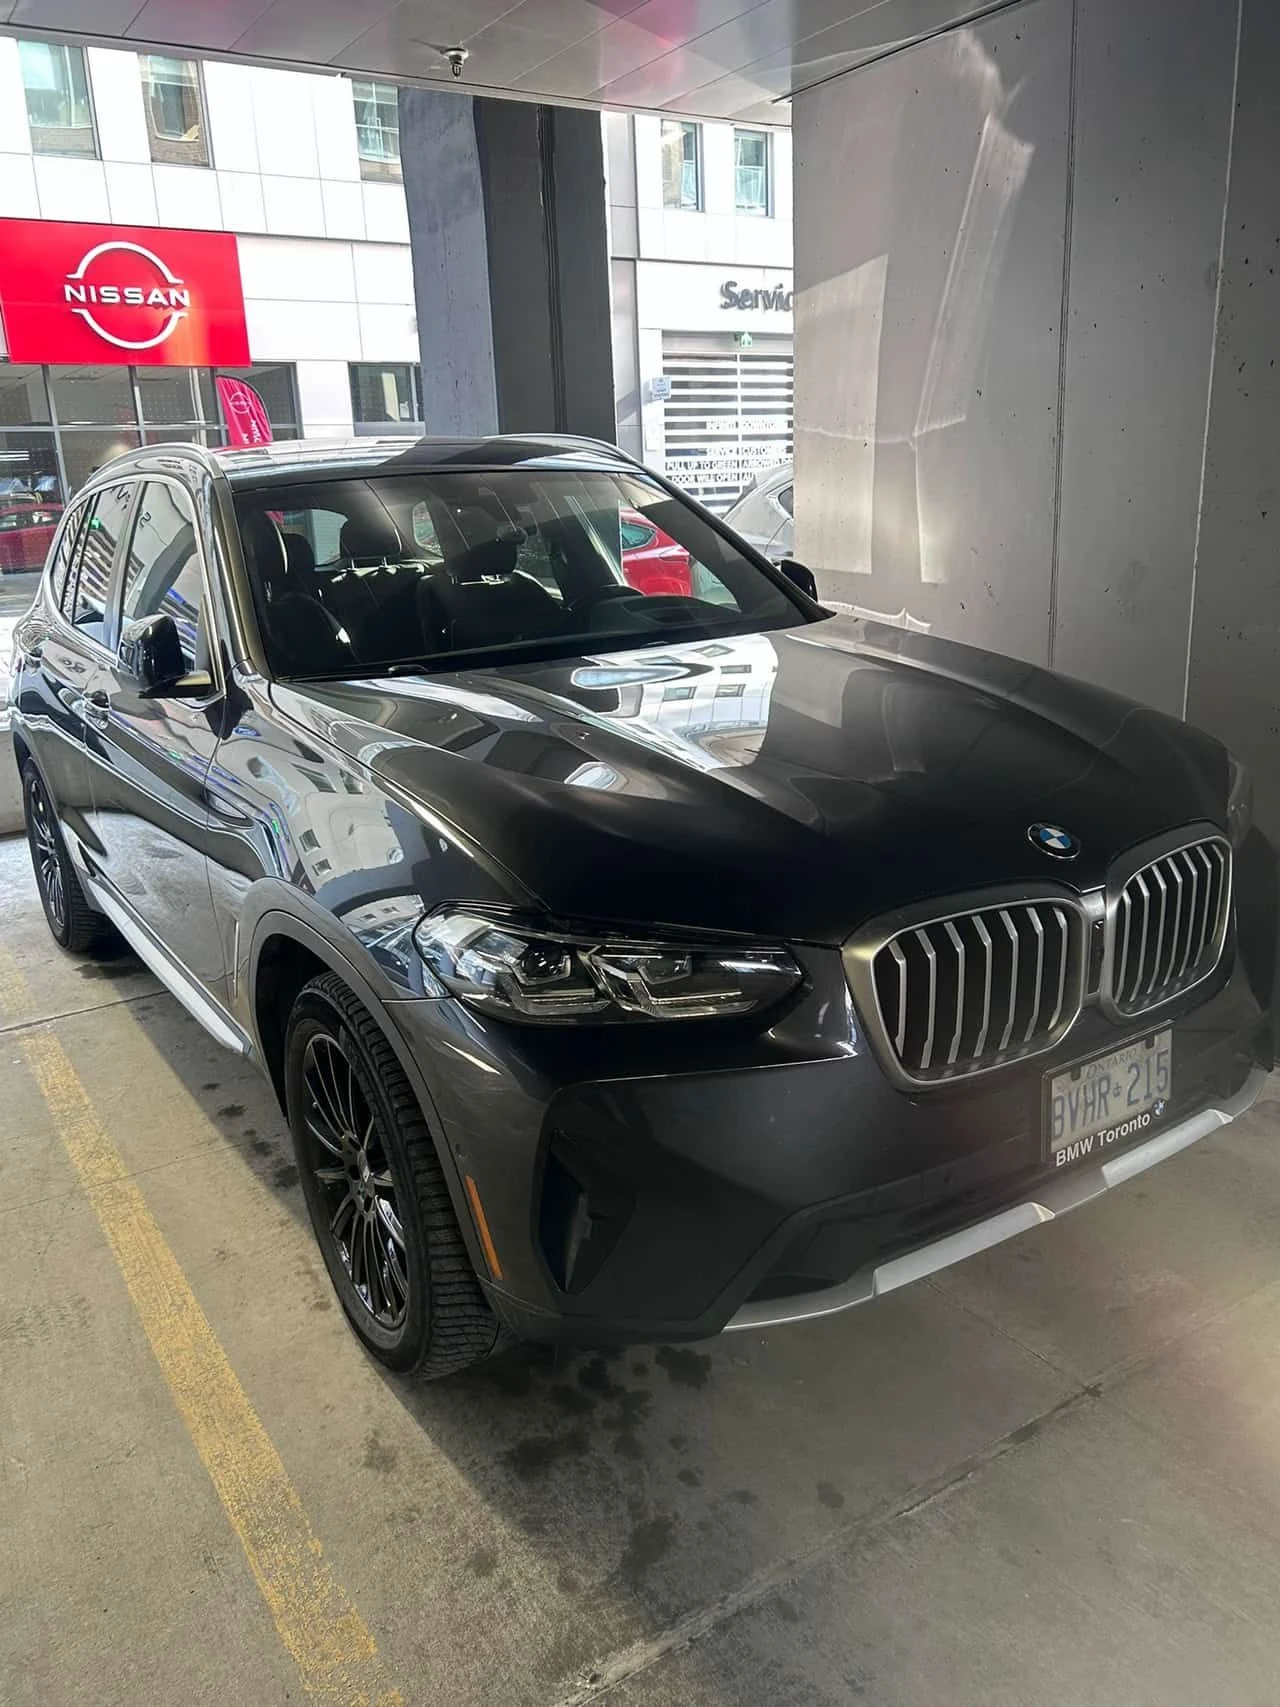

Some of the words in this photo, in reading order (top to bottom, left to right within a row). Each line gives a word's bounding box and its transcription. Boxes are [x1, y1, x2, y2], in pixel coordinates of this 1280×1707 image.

[64, 284, 190, 307] NISSAN
[720, 281, 793, 312] Servic
[712, 459, 737, 470] GREEN
[717, 472, 737, 482] OPEN
[1086, 1047, 1137, 1080] ONTARIO
[1053, 1073, 1111, 1140] BVHR
[1127, 1049, 1169, 1106] 215
[1056, 1135, 1094, 1167] BMW
[1098, 1113, 1151, 1147] Toronto
